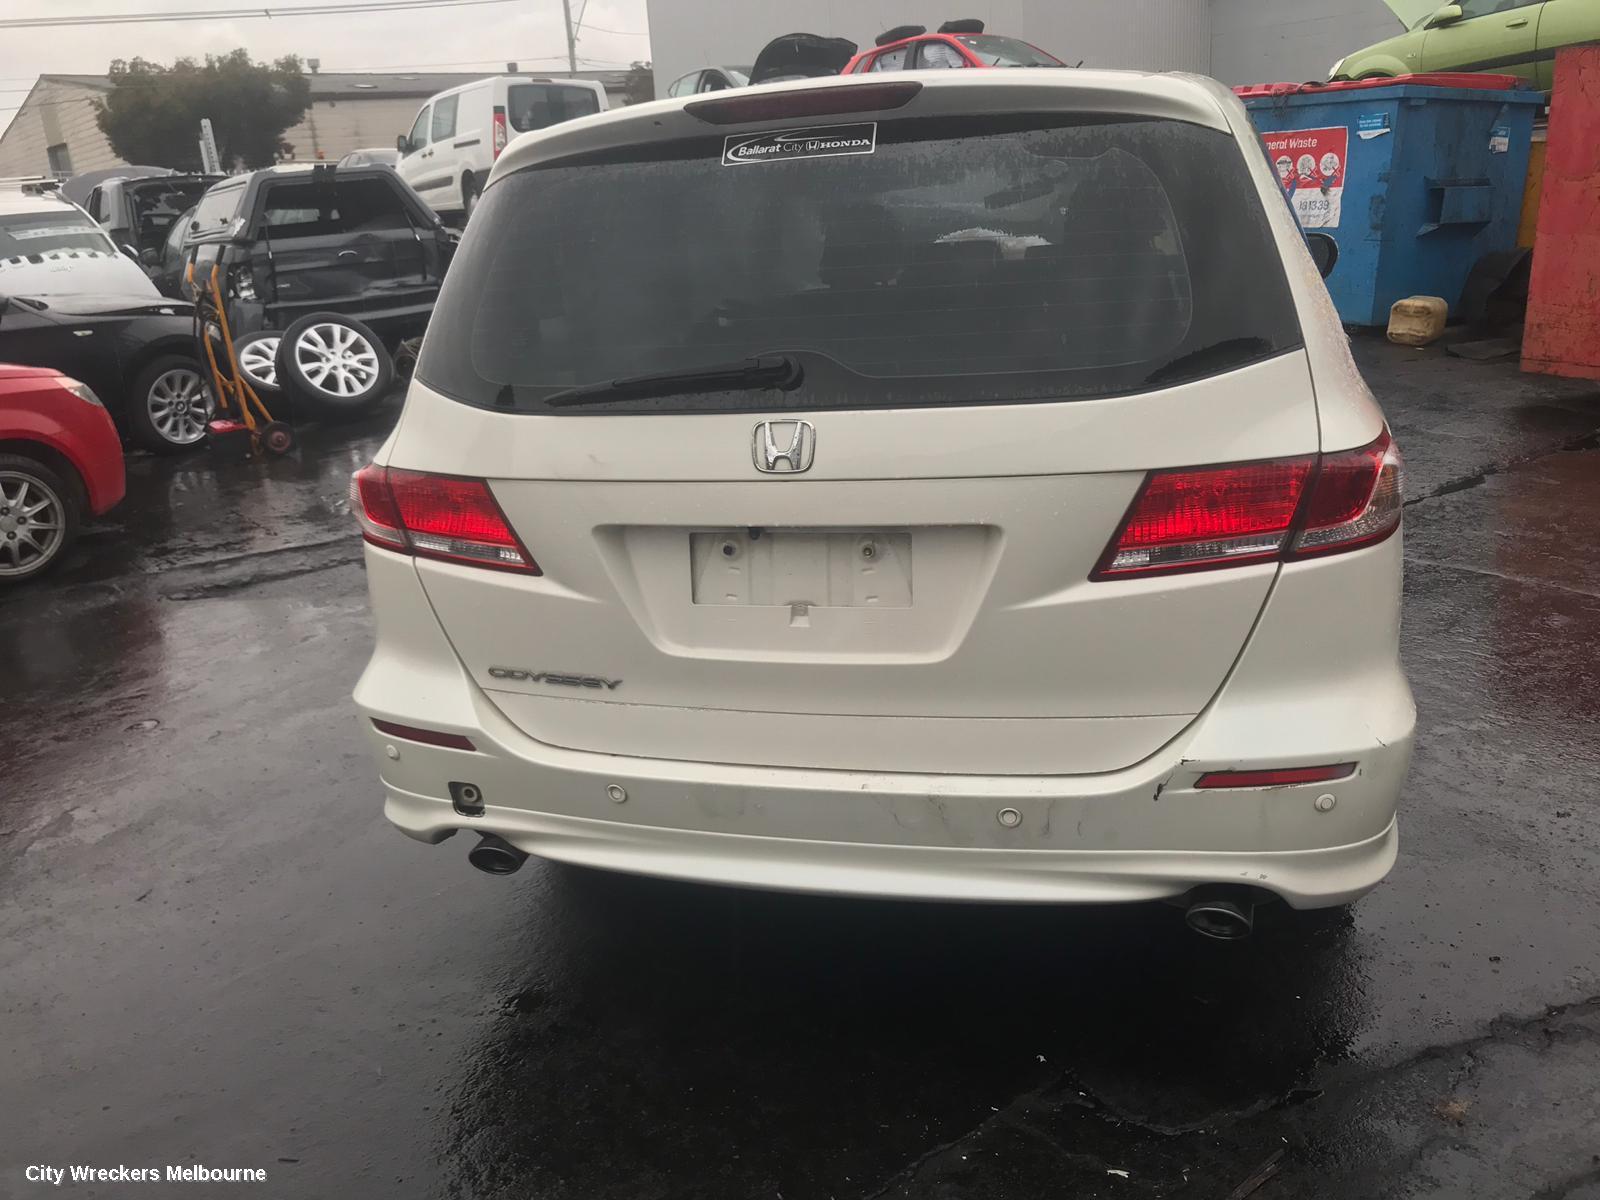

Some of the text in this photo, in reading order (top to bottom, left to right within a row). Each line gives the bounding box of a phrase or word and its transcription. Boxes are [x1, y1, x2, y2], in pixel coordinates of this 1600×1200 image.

[738, 144, 781, 156] Ballarat
[783, 142, 804, 153] City
[820, 139, 871, 149] HONDA
[1266, 137, 1318, 150] neral Waste
[488, 667, 623, 690] ODYSSEY
